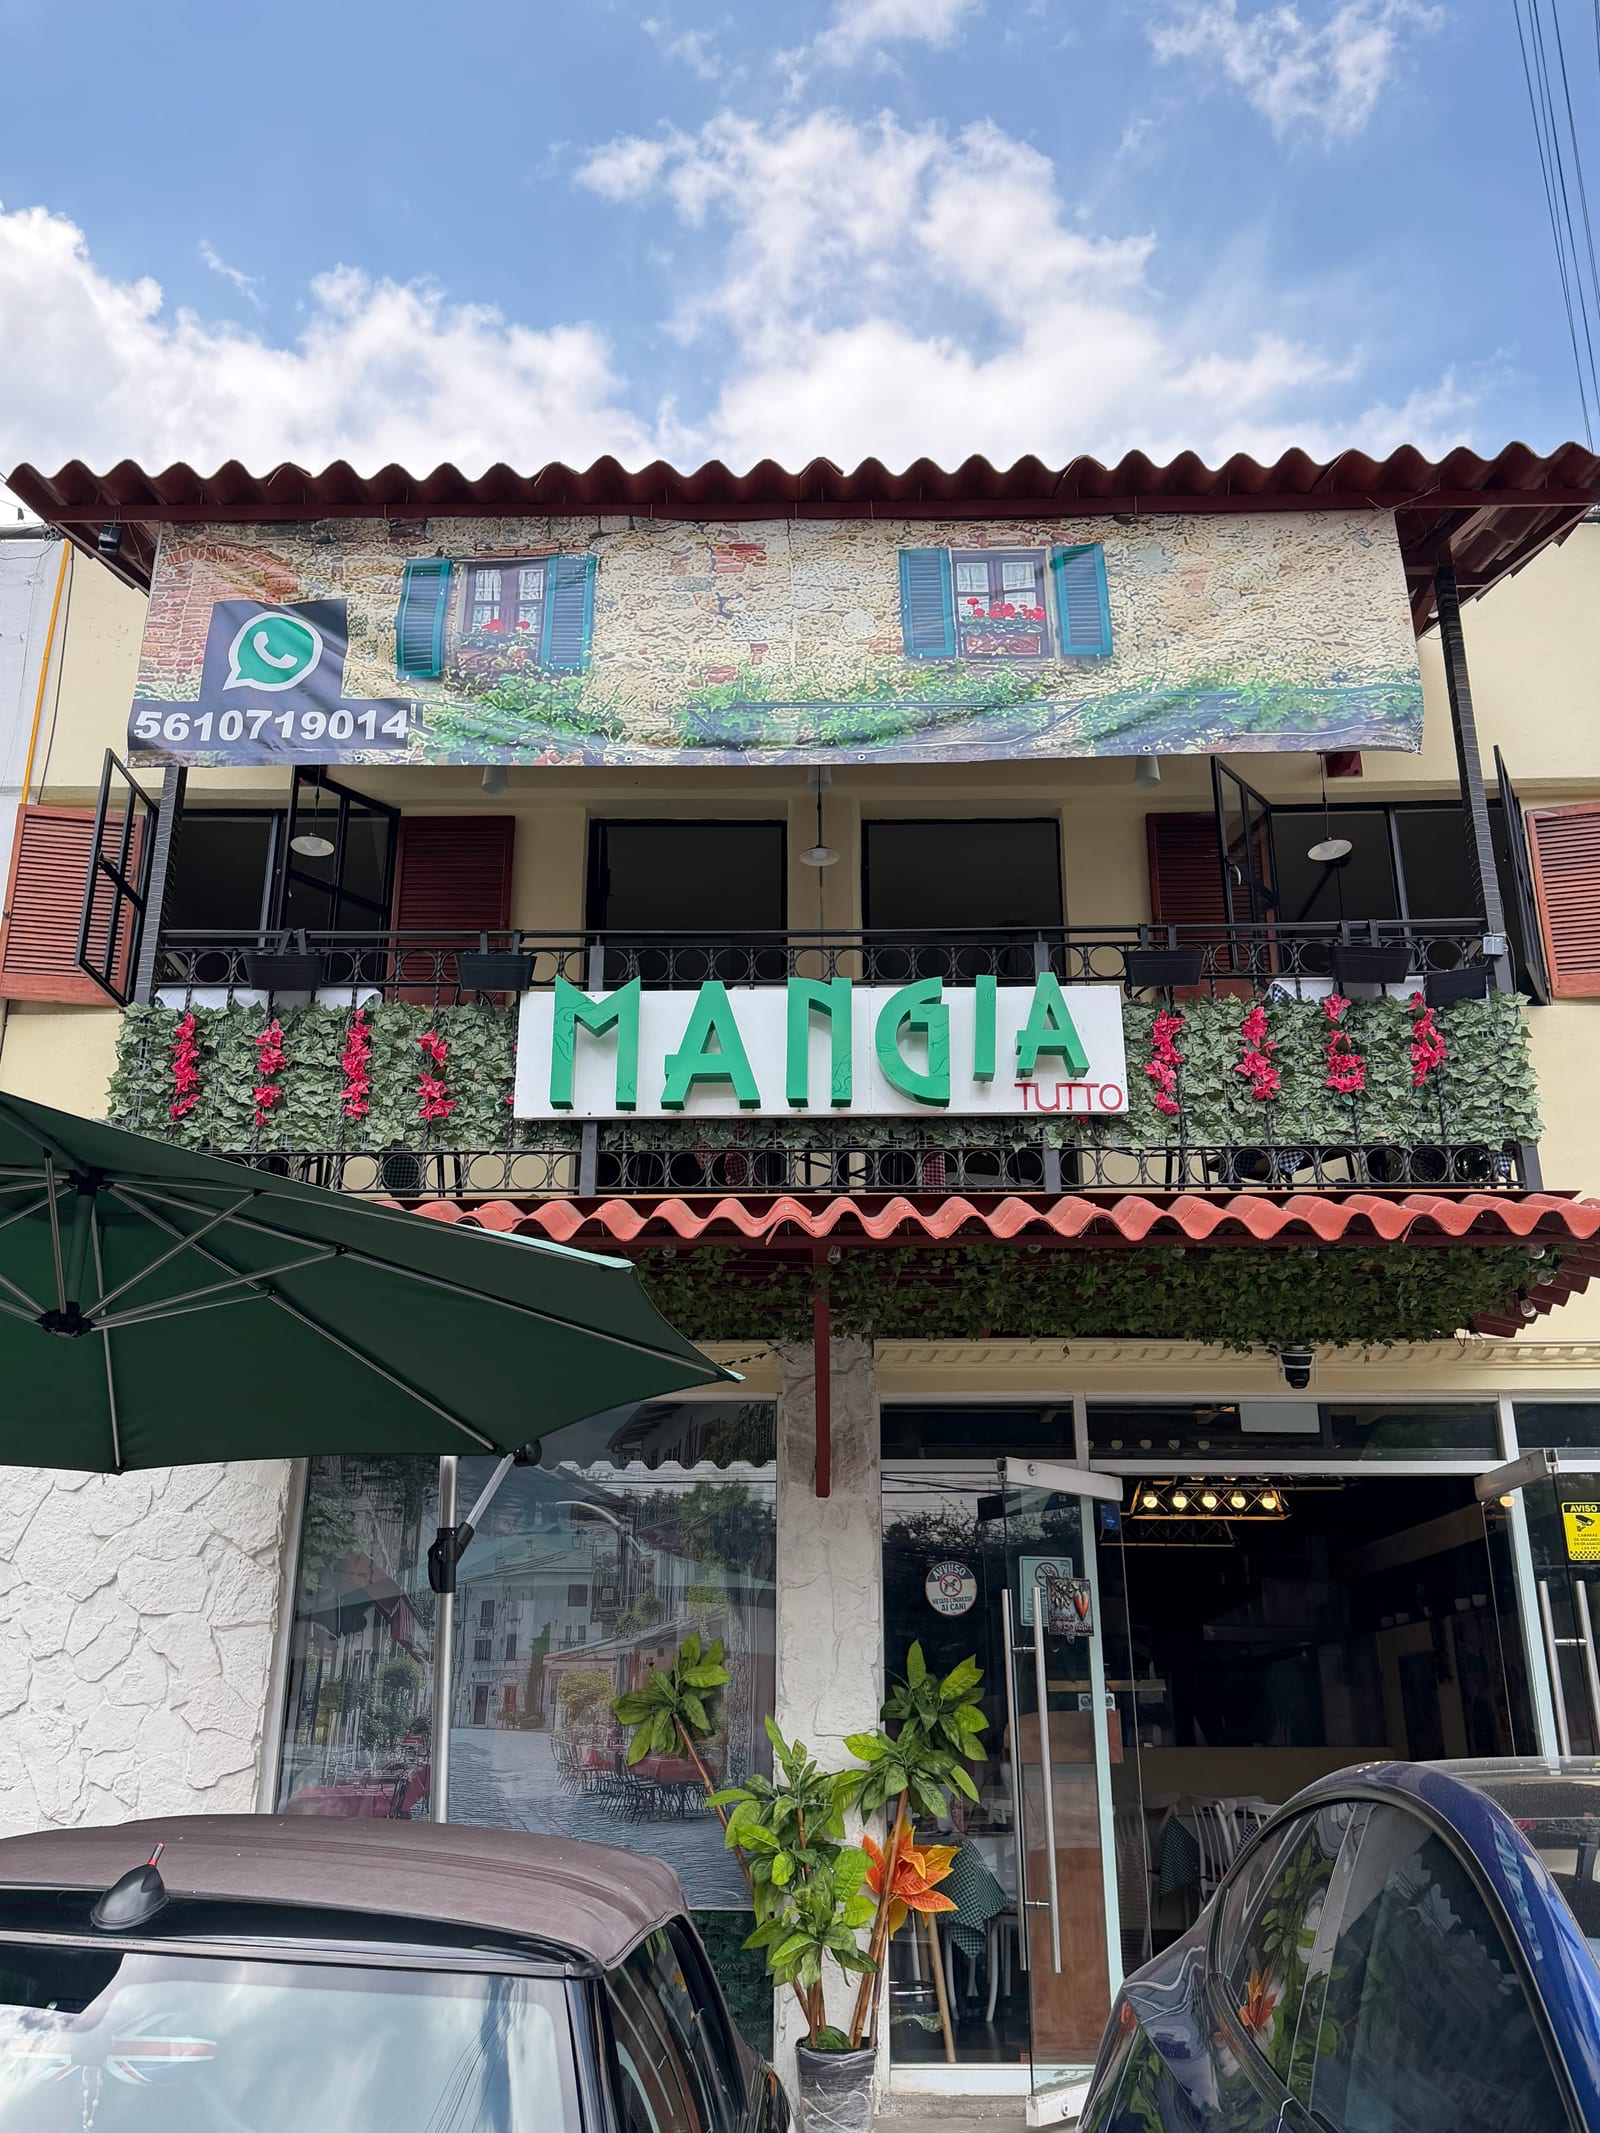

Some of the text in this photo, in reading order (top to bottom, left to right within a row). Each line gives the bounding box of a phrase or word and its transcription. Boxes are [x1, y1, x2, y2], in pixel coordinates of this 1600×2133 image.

[133, 709, 409, 741] 5610719014
[549, 971, 1090, 1111] MANGIA
[1014, 1082, 1122, 1111] TUTTO
[1570, 1504, 1598, 1512] AVISO
